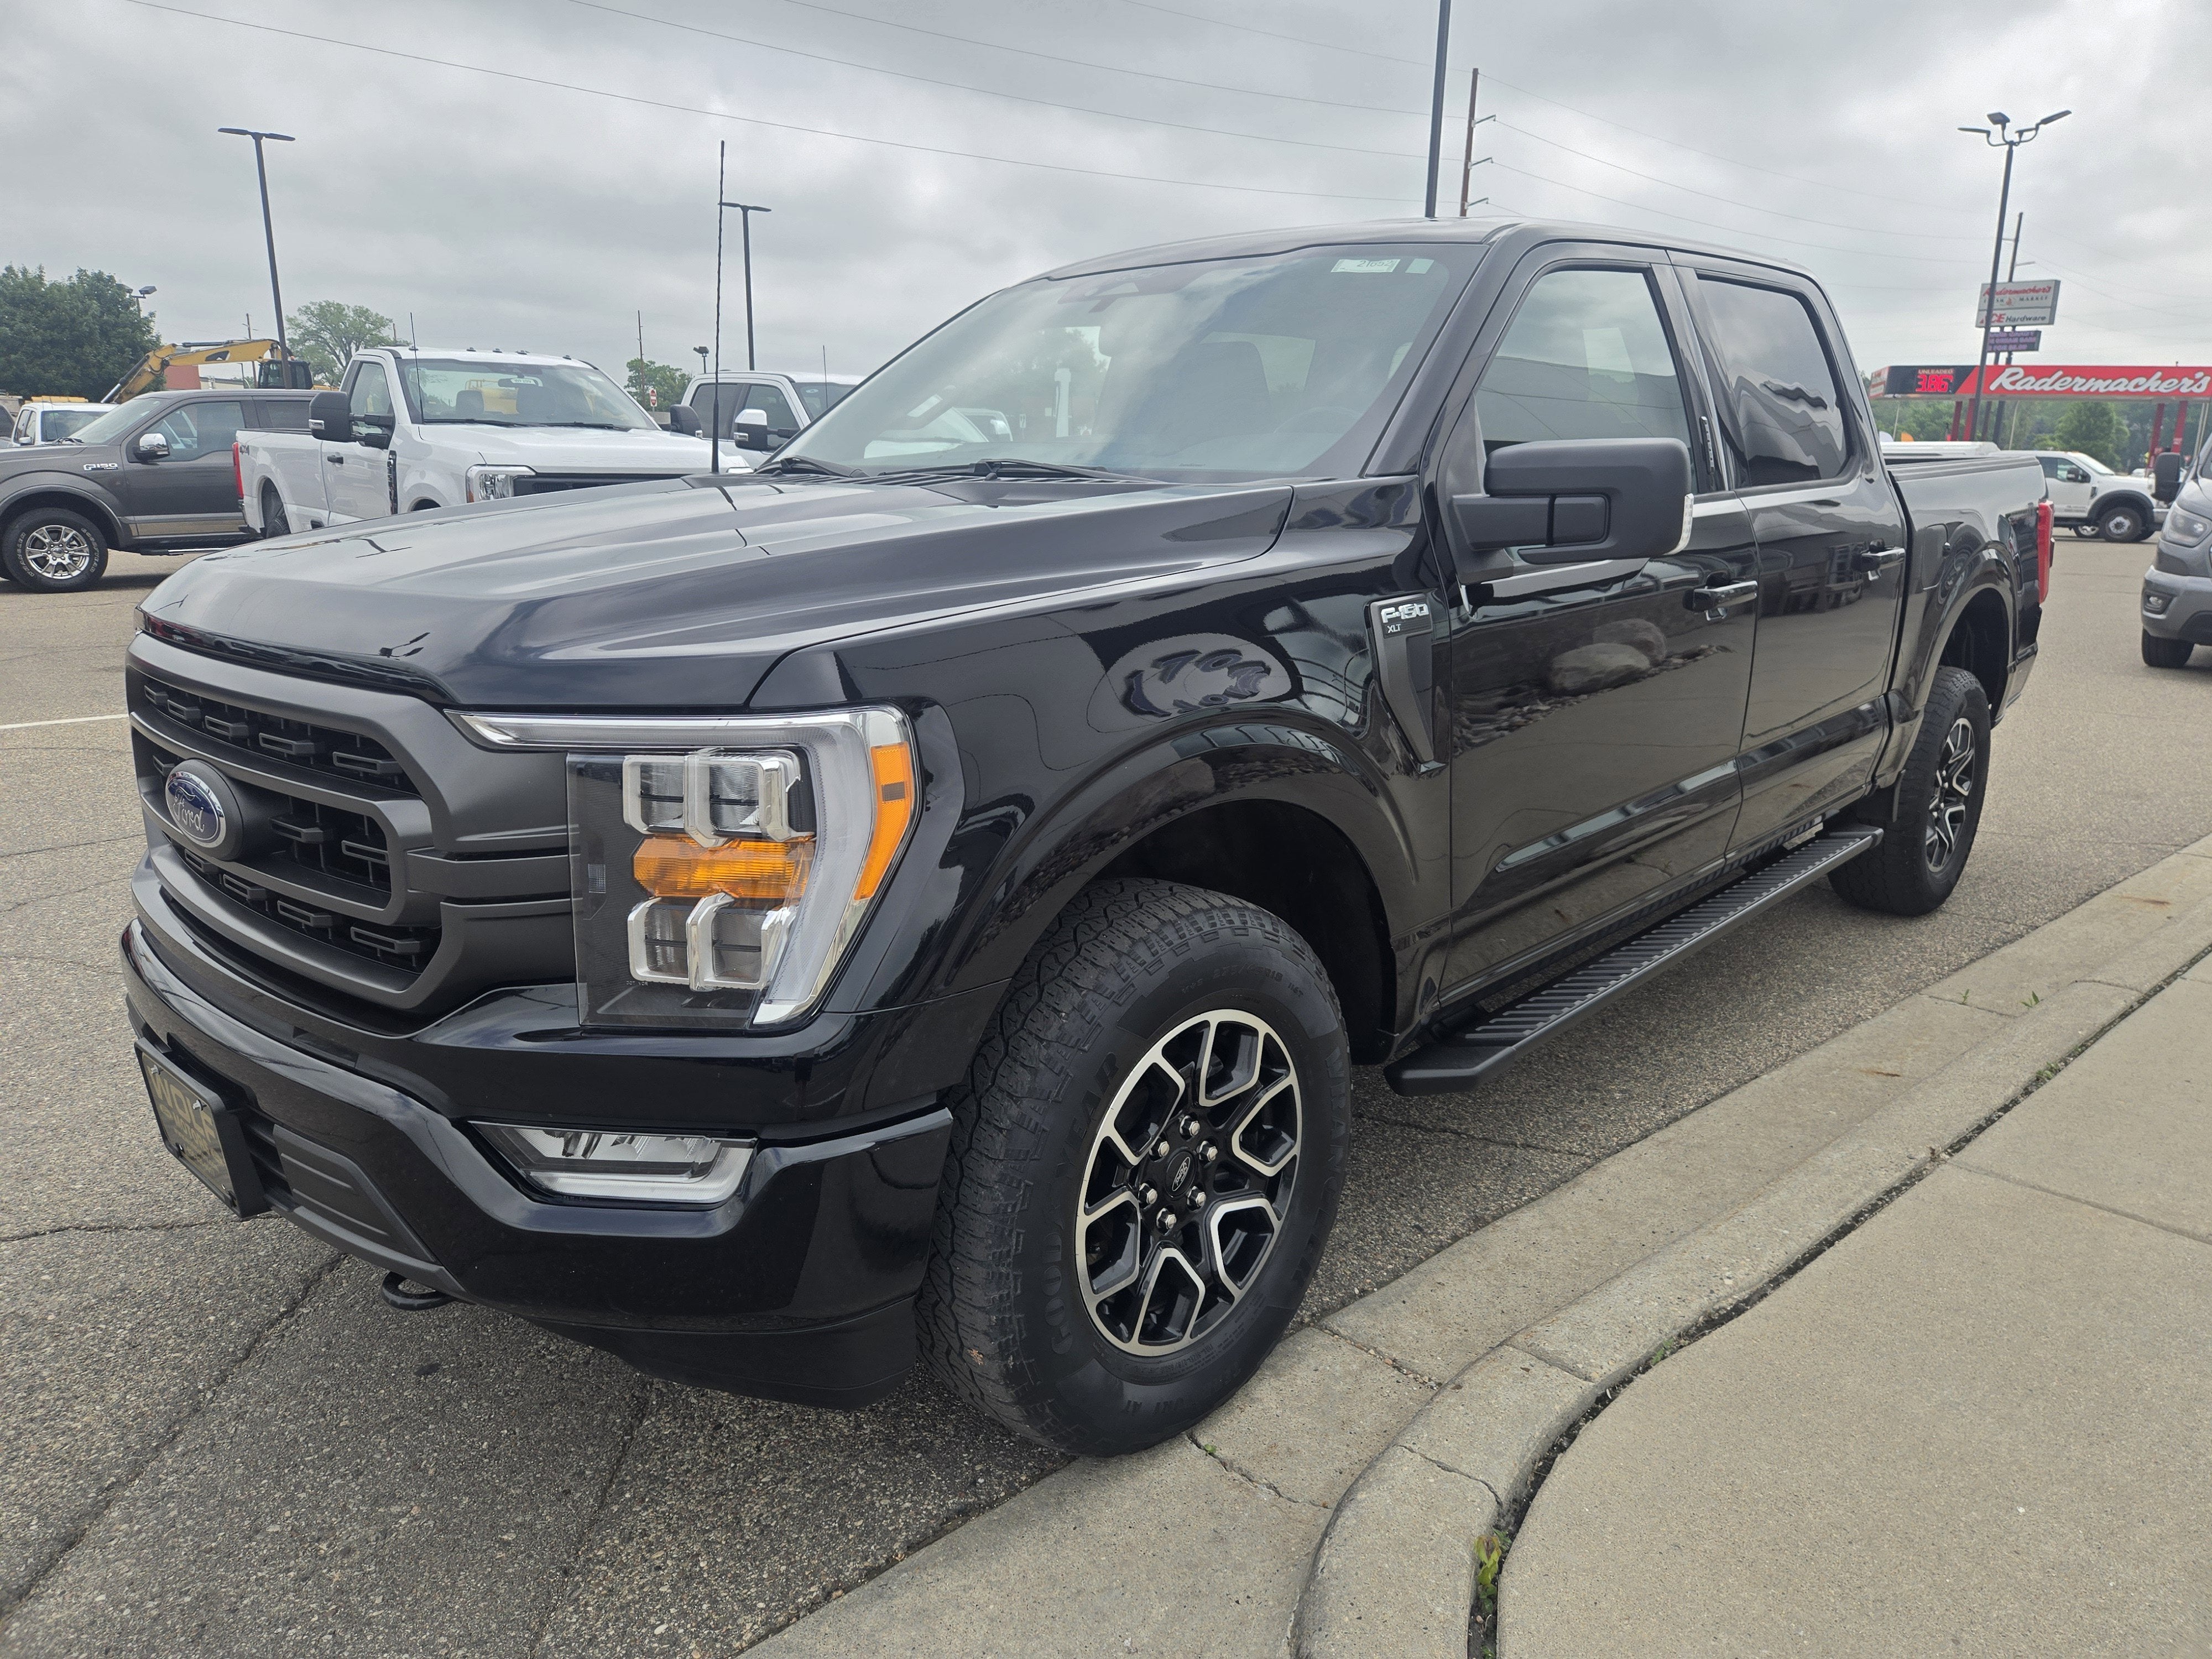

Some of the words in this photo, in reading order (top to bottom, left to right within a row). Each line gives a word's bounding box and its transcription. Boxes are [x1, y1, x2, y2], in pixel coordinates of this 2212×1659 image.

[2005, 315, 2046, 323] Hardware
[1990, 367, 2211, 394] Radermacher's
[1387, 623, 1401, 634] XLT
[173, 786, 205, 833] Ford
[146, 1065, 217, 1144] WOLF
